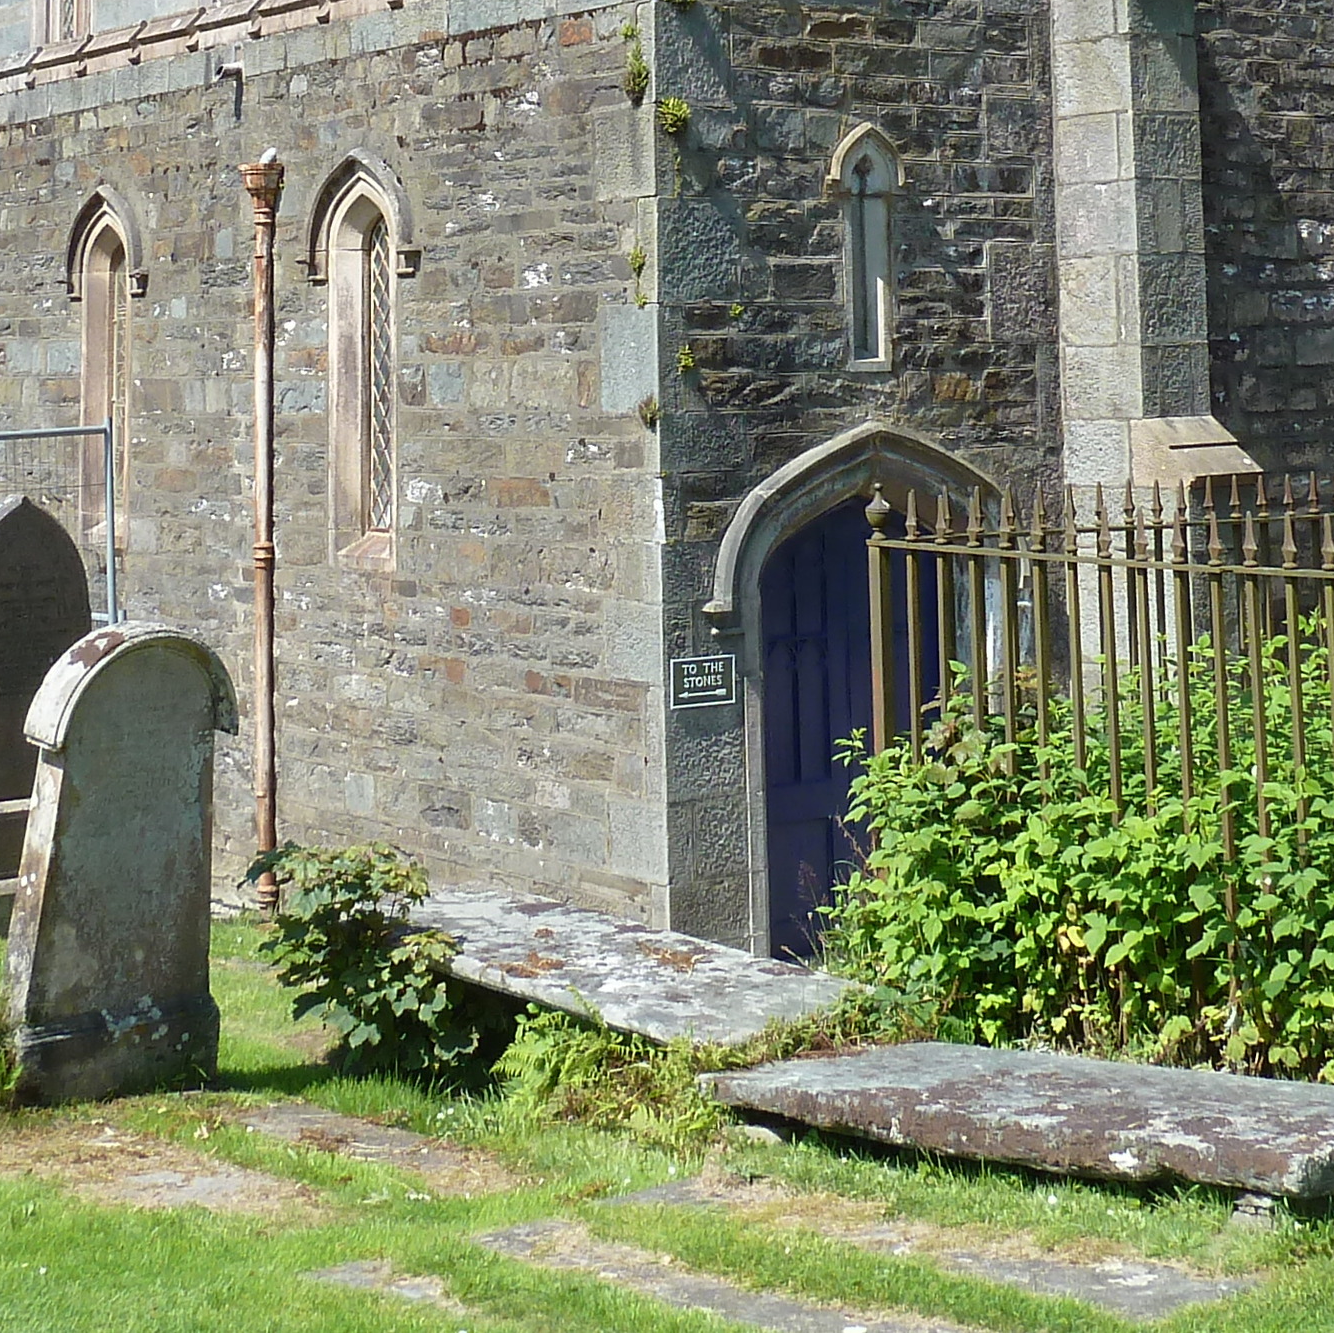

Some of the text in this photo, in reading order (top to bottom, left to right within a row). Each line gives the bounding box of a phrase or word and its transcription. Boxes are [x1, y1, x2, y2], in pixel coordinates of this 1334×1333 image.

[681, 661, 724, 675] TO THE
[683, 675, 722, 688] STONES
